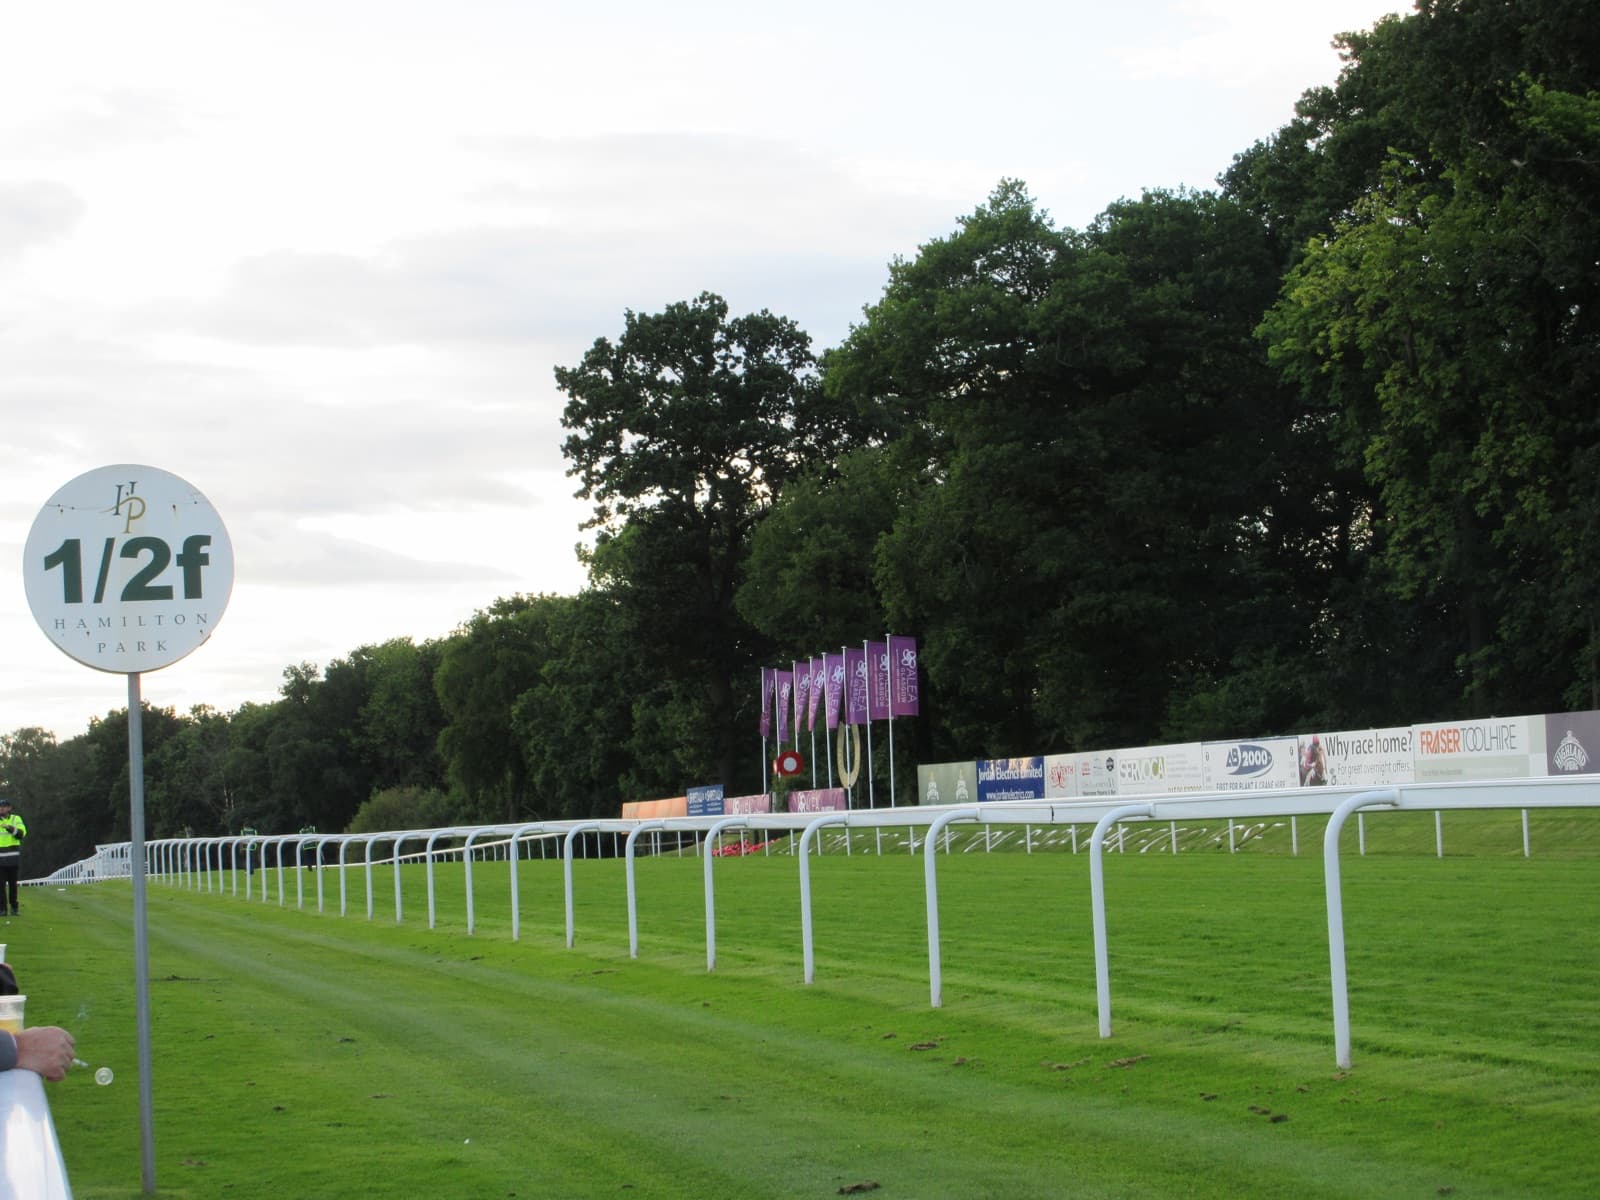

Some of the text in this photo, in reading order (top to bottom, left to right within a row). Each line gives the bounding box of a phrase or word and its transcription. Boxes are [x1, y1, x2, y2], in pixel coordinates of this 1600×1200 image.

[44, 535, 212, 604] 1/2f
[54, 613, 209, 630] HAMILTON
[97, 640, 168, 654] PARK
[906, 668, 918, 703] ALEA
[1325, 731, 1413, 760] Why race home?
[1553, 741, 1587, 770] HIGHLAND
[1337, 763, 1347, 776] For
[1347, 763, 1362, 778] great
[1363, 761, 1392, 777] overnight
